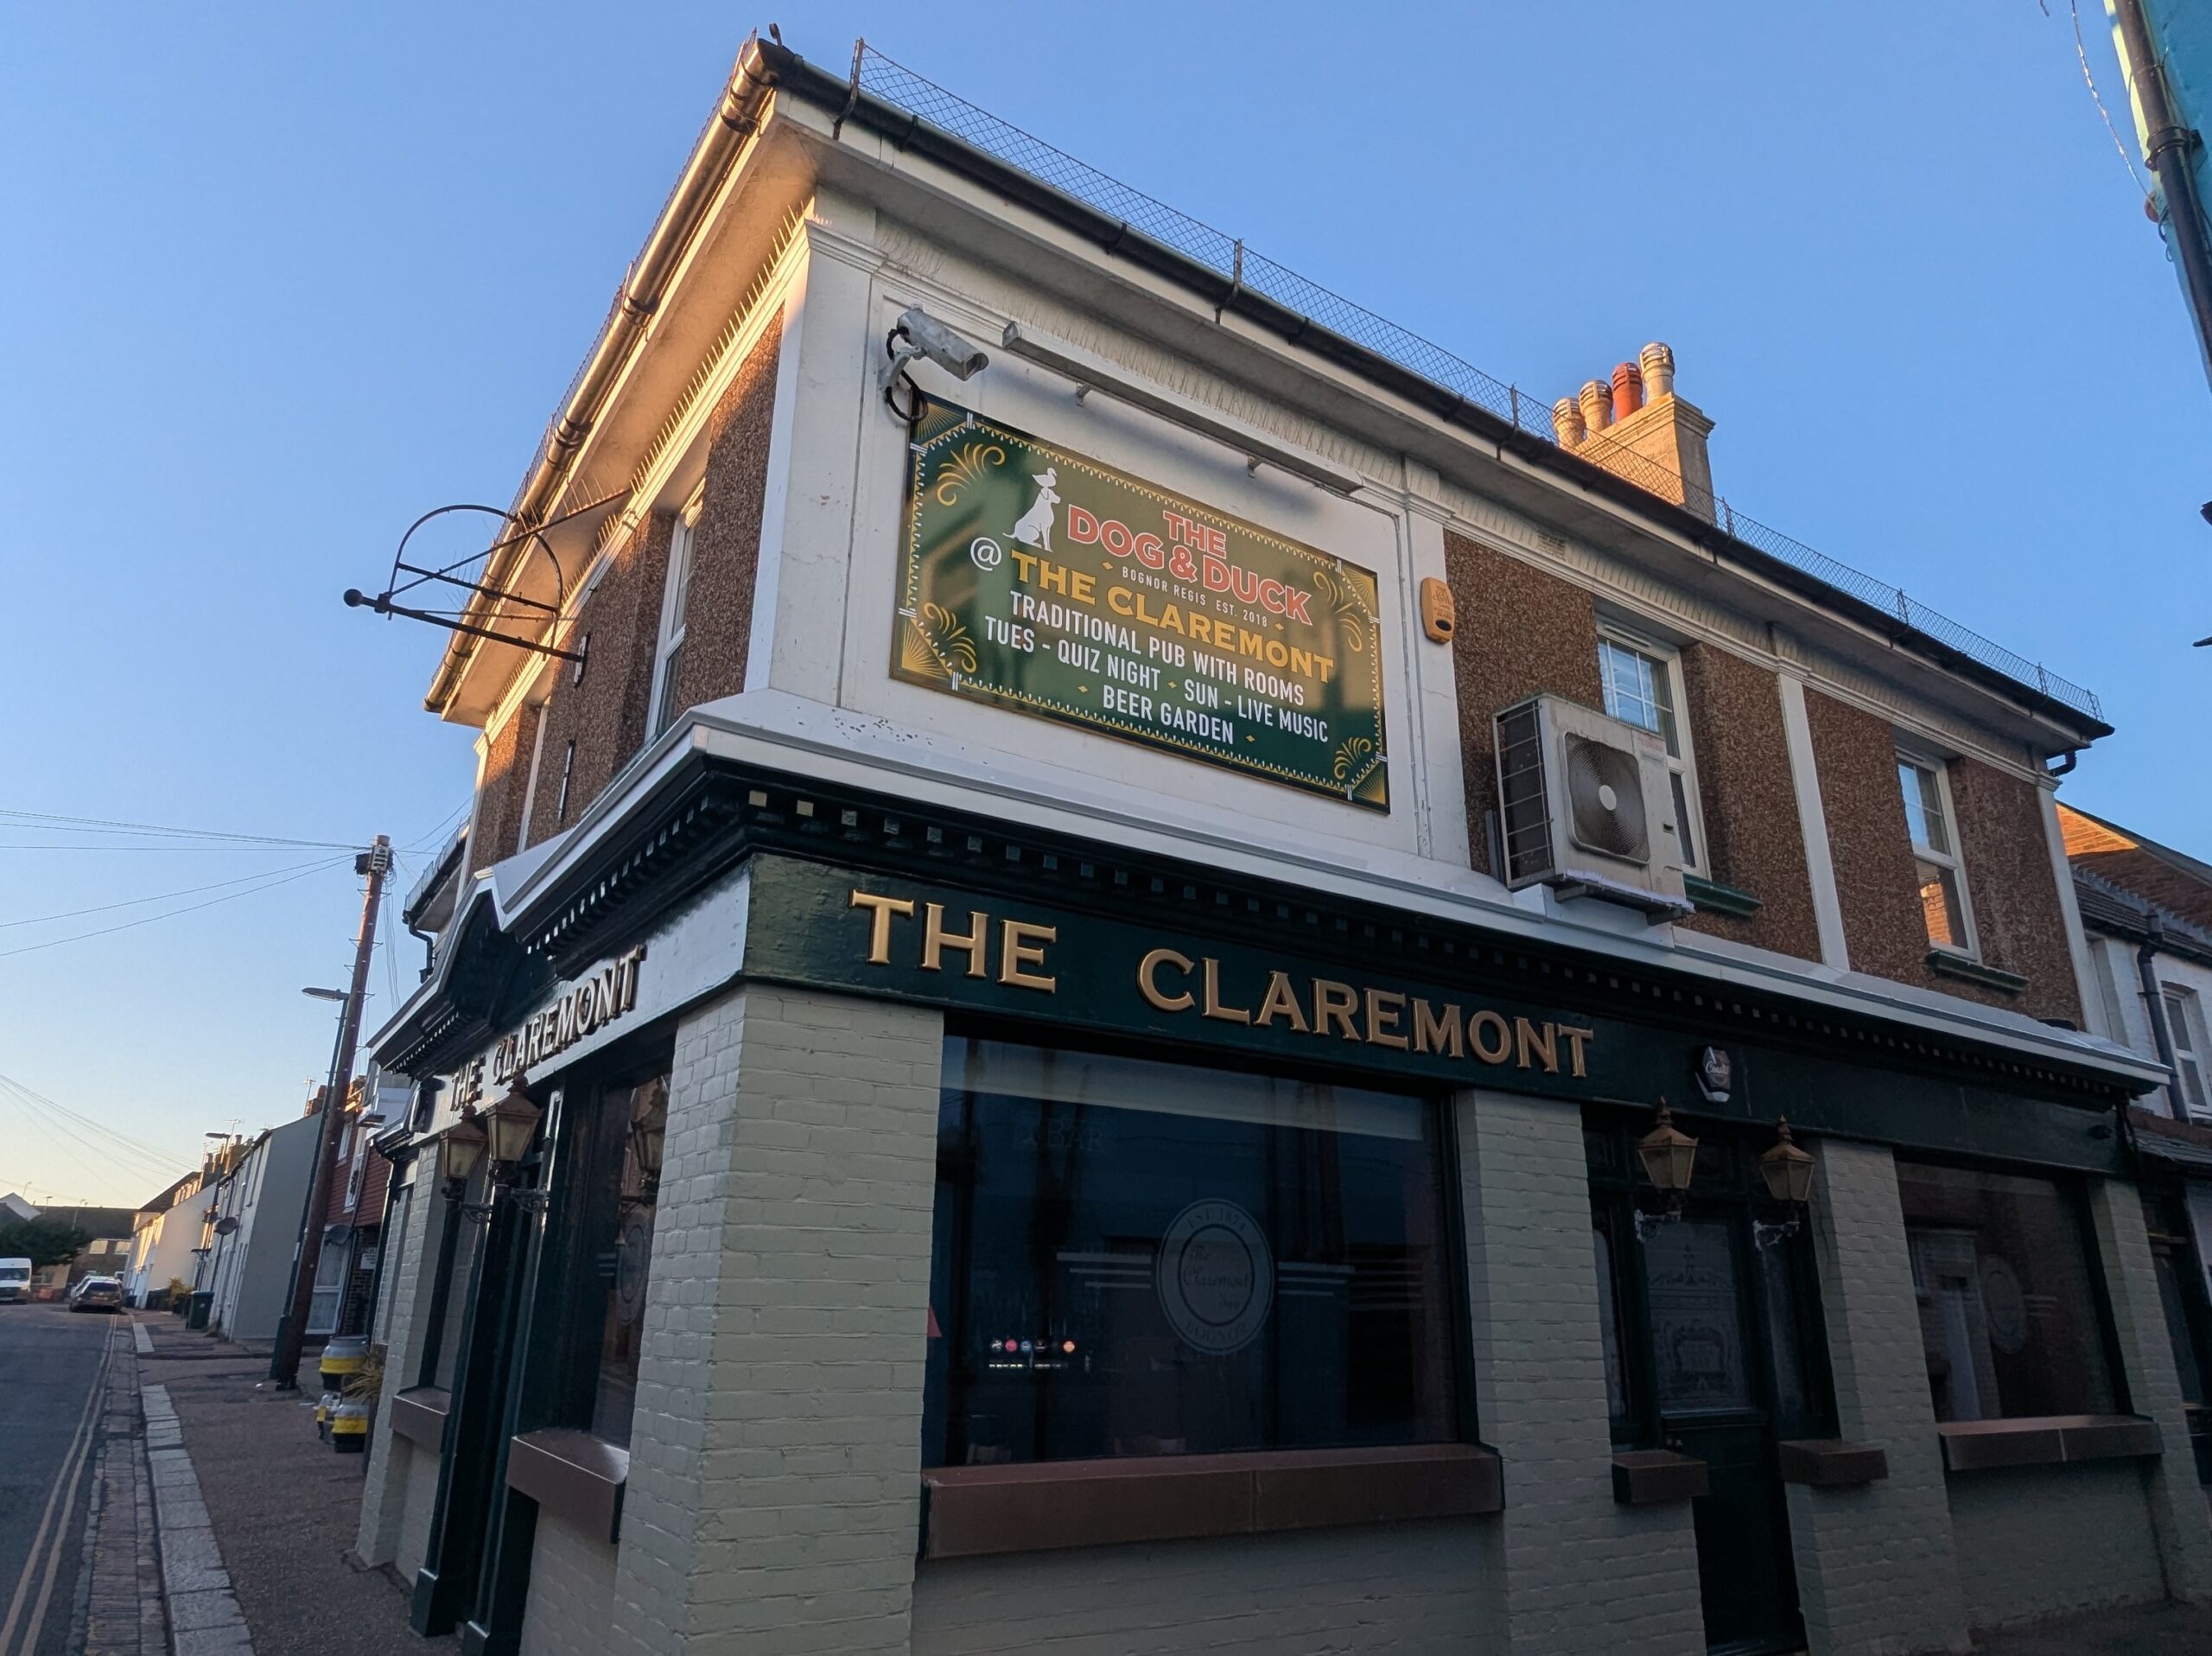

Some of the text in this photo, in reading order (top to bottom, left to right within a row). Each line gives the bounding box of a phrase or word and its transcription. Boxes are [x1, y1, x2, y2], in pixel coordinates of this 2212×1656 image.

[1068, 504, 1313, 627] DOG & DUCK
[1163, 510, 1226, 559] THE
[969, 537, 1334, 683] @ THE CLAREMONT
[1010, 590, 1304, 706] TRADITIONAL PUB WITH ROOMS
[1122, 566, 1268, 627] BOGNOR REGIS EST. 2018
[985, 615, 1035, 653] TUES
[1058, 639, 1101, 673] QUIZ
[1107, 653, 1160, 691] NIGHT
[1185, 678, 1218, 710] SUN
[1238, 695, 1273, 727] LIVE
[1279, 708, 1328, 742] MUSIC
[1103, 685, 1233, 744] BEER GARDEN
[449, 944, 648, 1111] THE CLAREMONT
[849, 889, 1595, 1079] THE CLAREMONT
